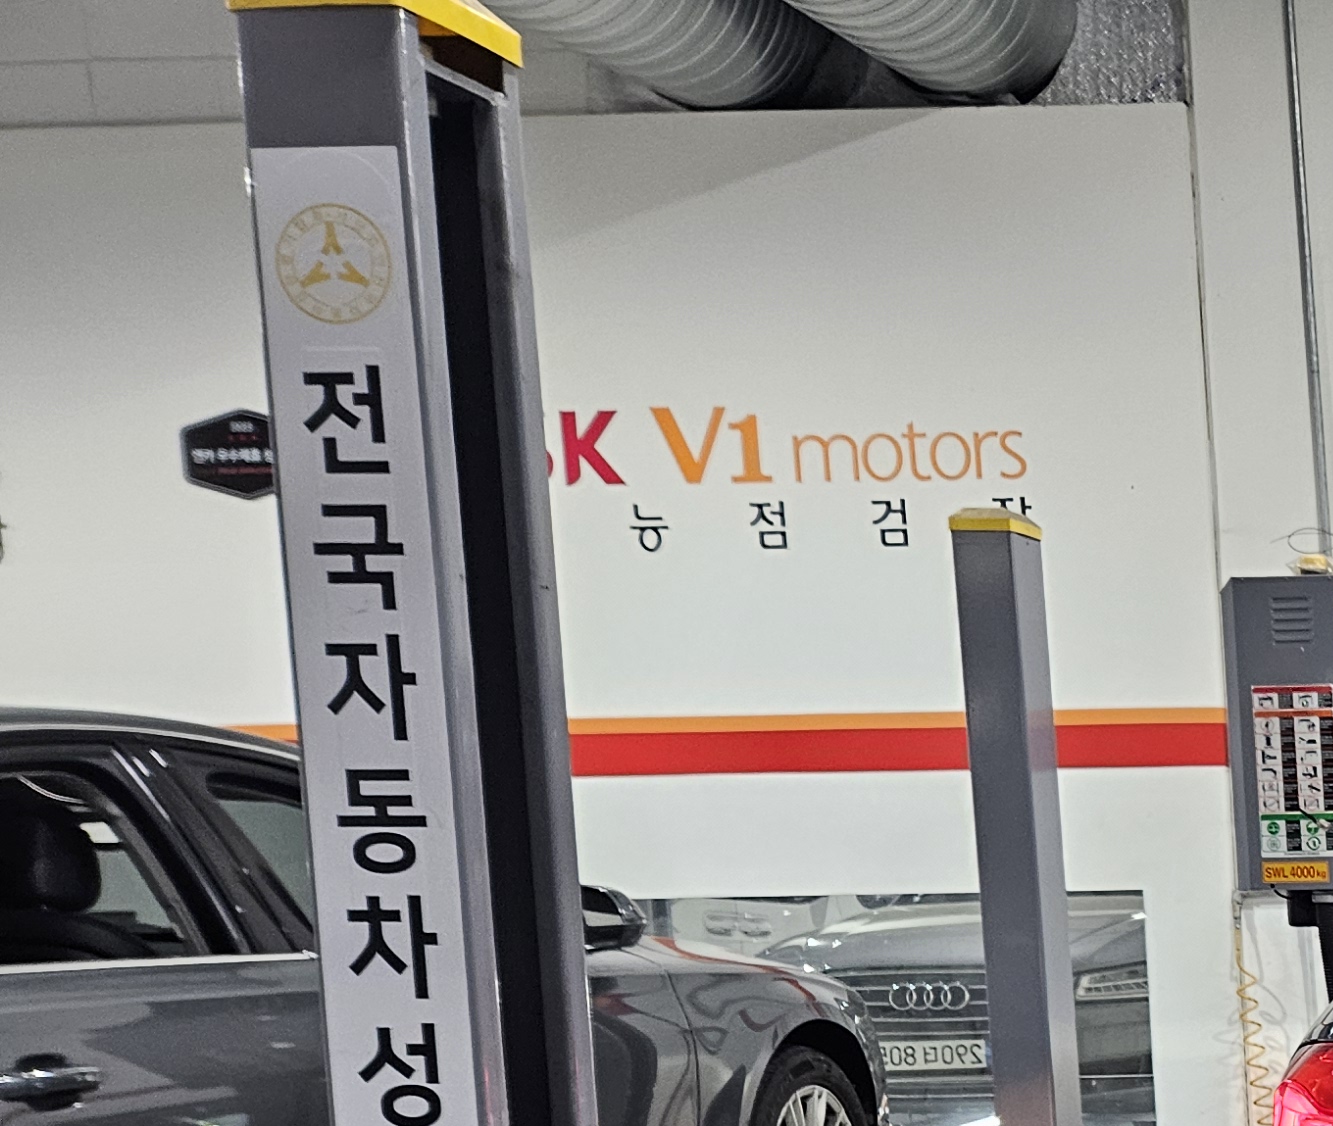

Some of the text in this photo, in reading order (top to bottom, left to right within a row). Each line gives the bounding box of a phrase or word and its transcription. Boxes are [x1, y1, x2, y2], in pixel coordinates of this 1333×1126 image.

[546, 406, 1028, 486] K V1 motors
[1265, 867, 1288, 879] SWL
